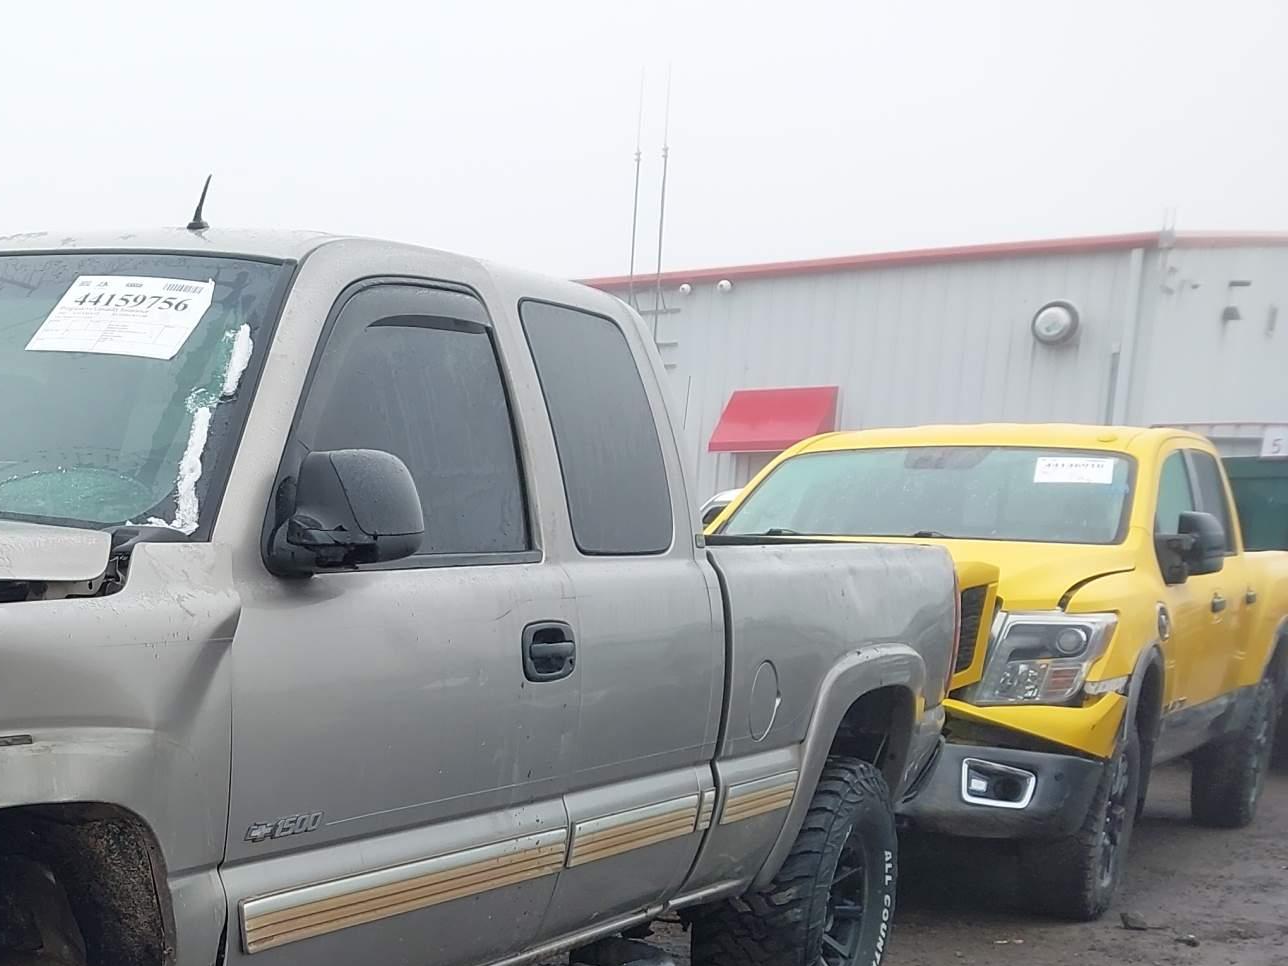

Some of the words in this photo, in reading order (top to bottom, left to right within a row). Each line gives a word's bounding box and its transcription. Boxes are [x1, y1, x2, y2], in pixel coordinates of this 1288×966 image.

[73, 292, 193, 312] 44159756
[274, 812, 323, 838] 1500
[884, 850, 893, 886] ALL
